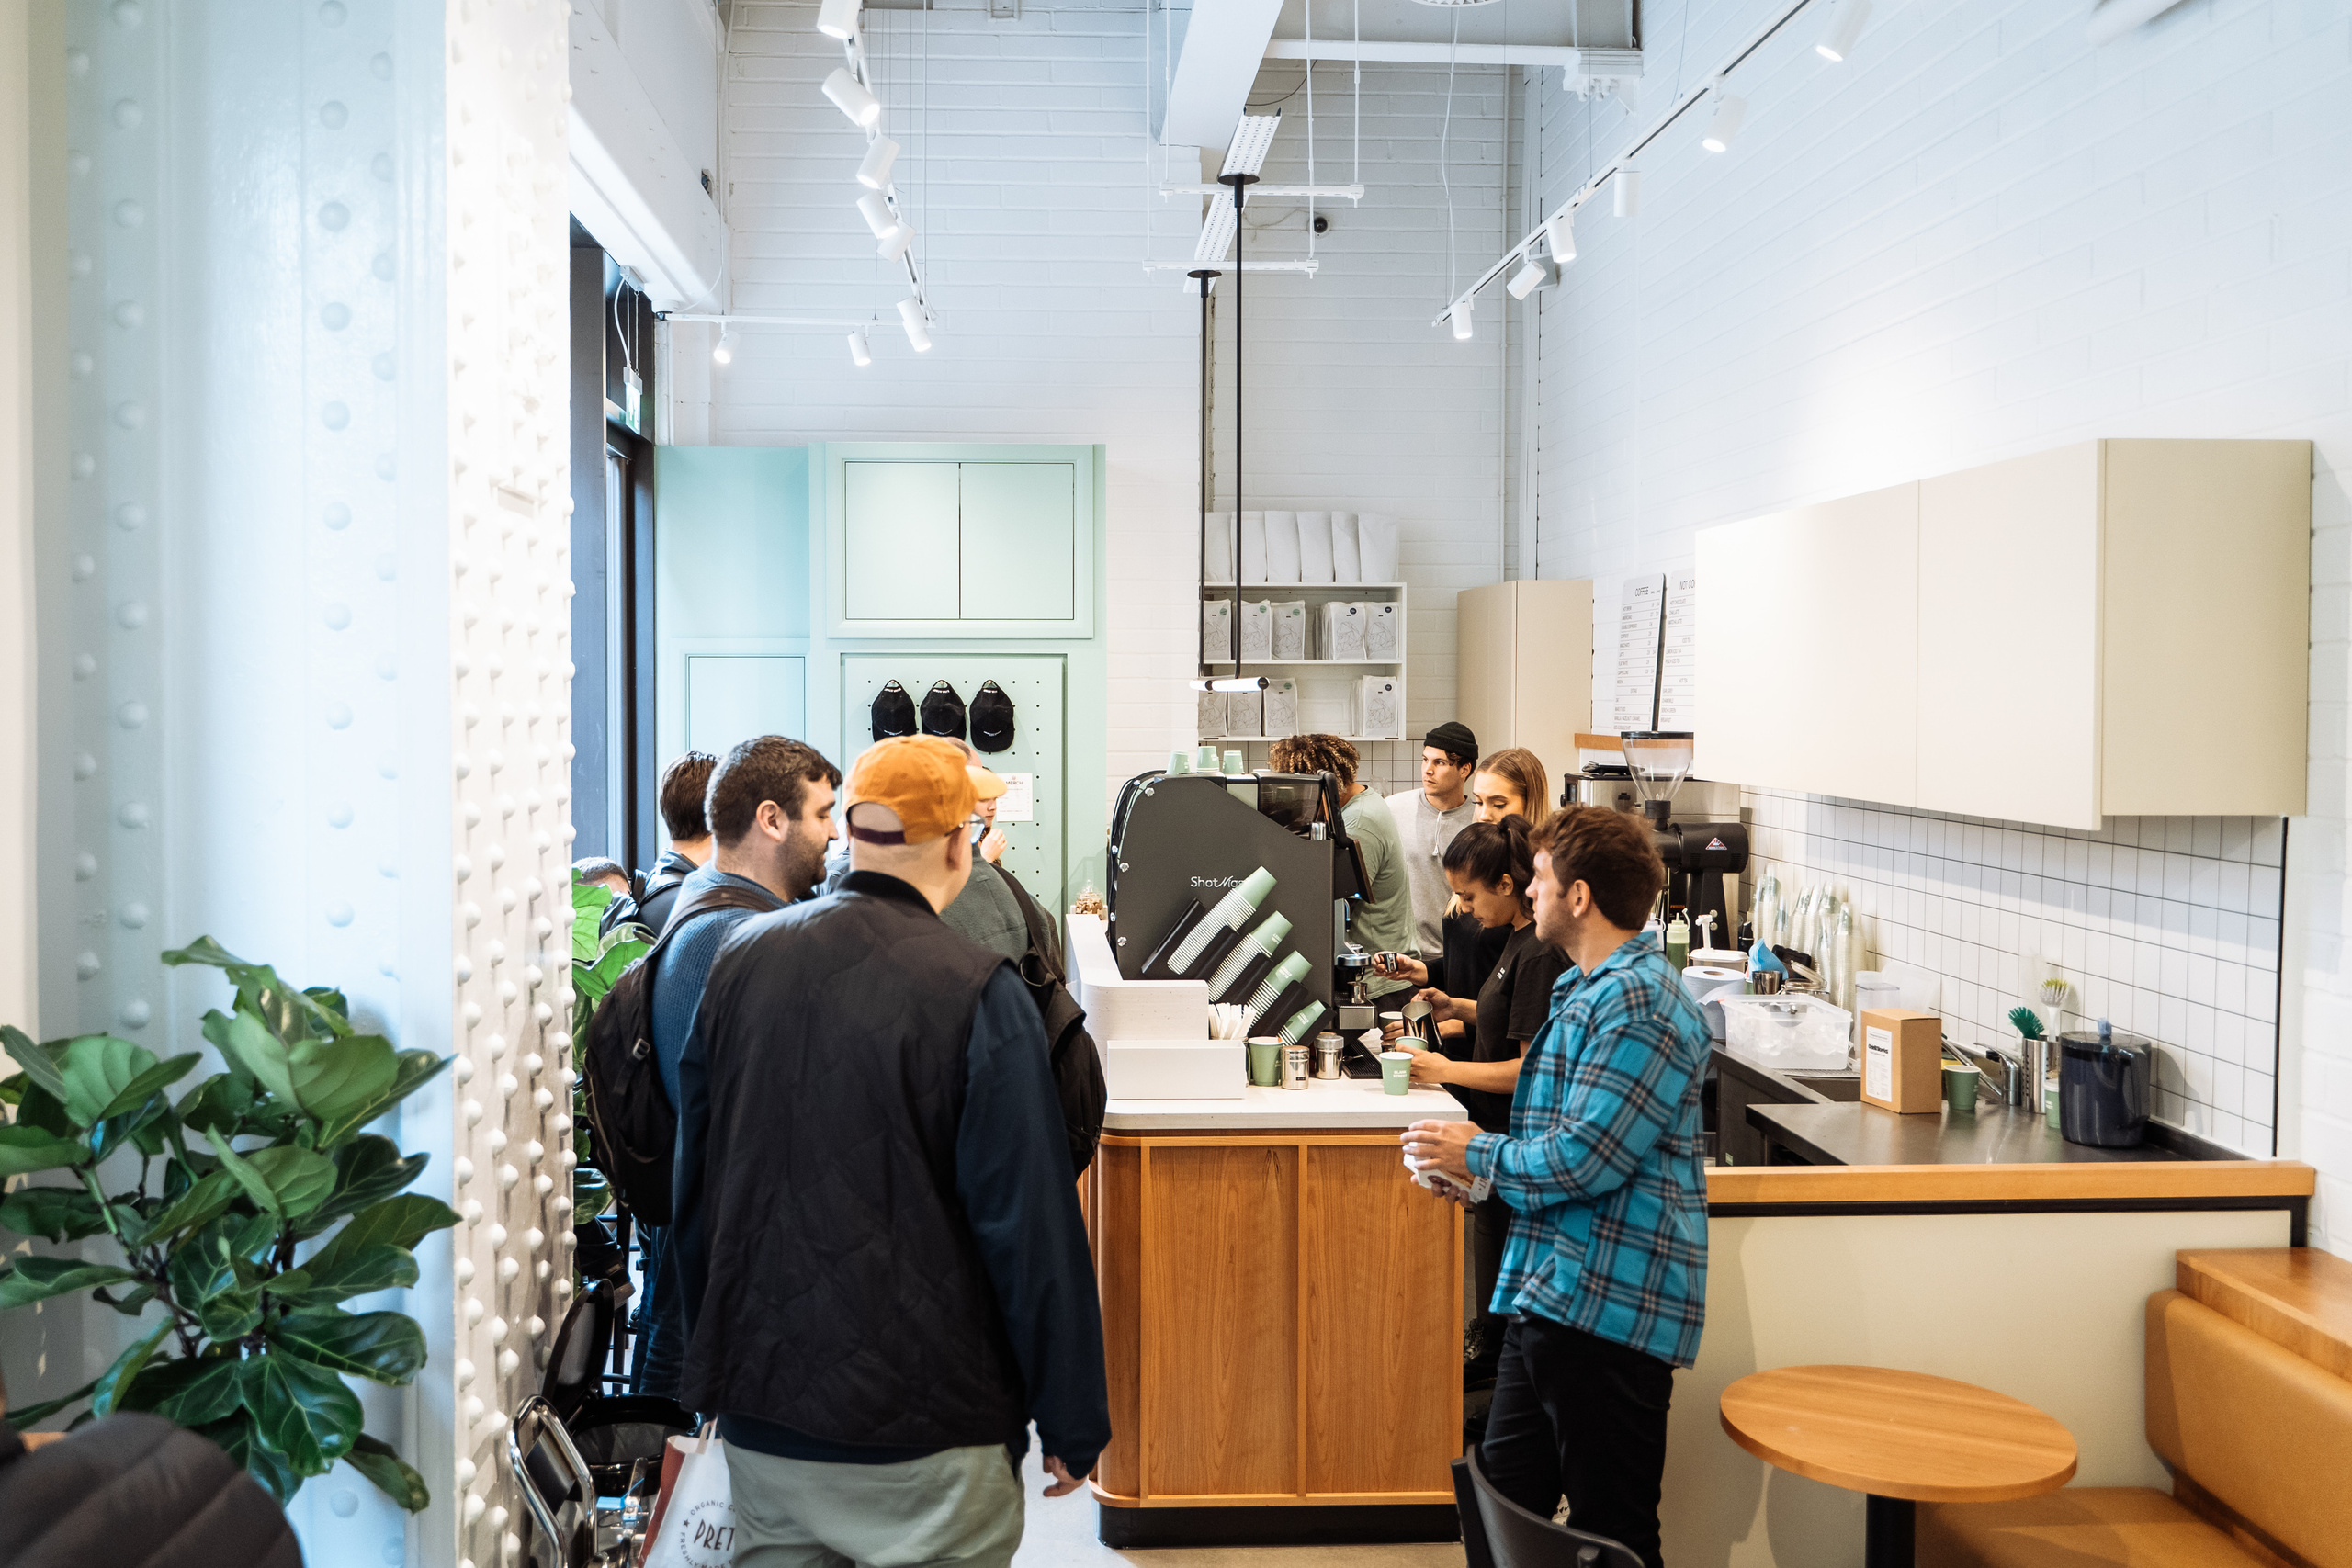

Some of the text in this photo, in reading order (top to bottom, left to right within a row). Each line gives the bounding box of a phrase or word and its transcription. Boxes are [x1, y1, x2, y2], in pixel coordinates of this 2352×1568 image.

[690, 1500, 724, 1516] ORGANIC
[680, 1531, 698, 1568] FRESHLY
[693, 1518, 735, 1551] PRET
